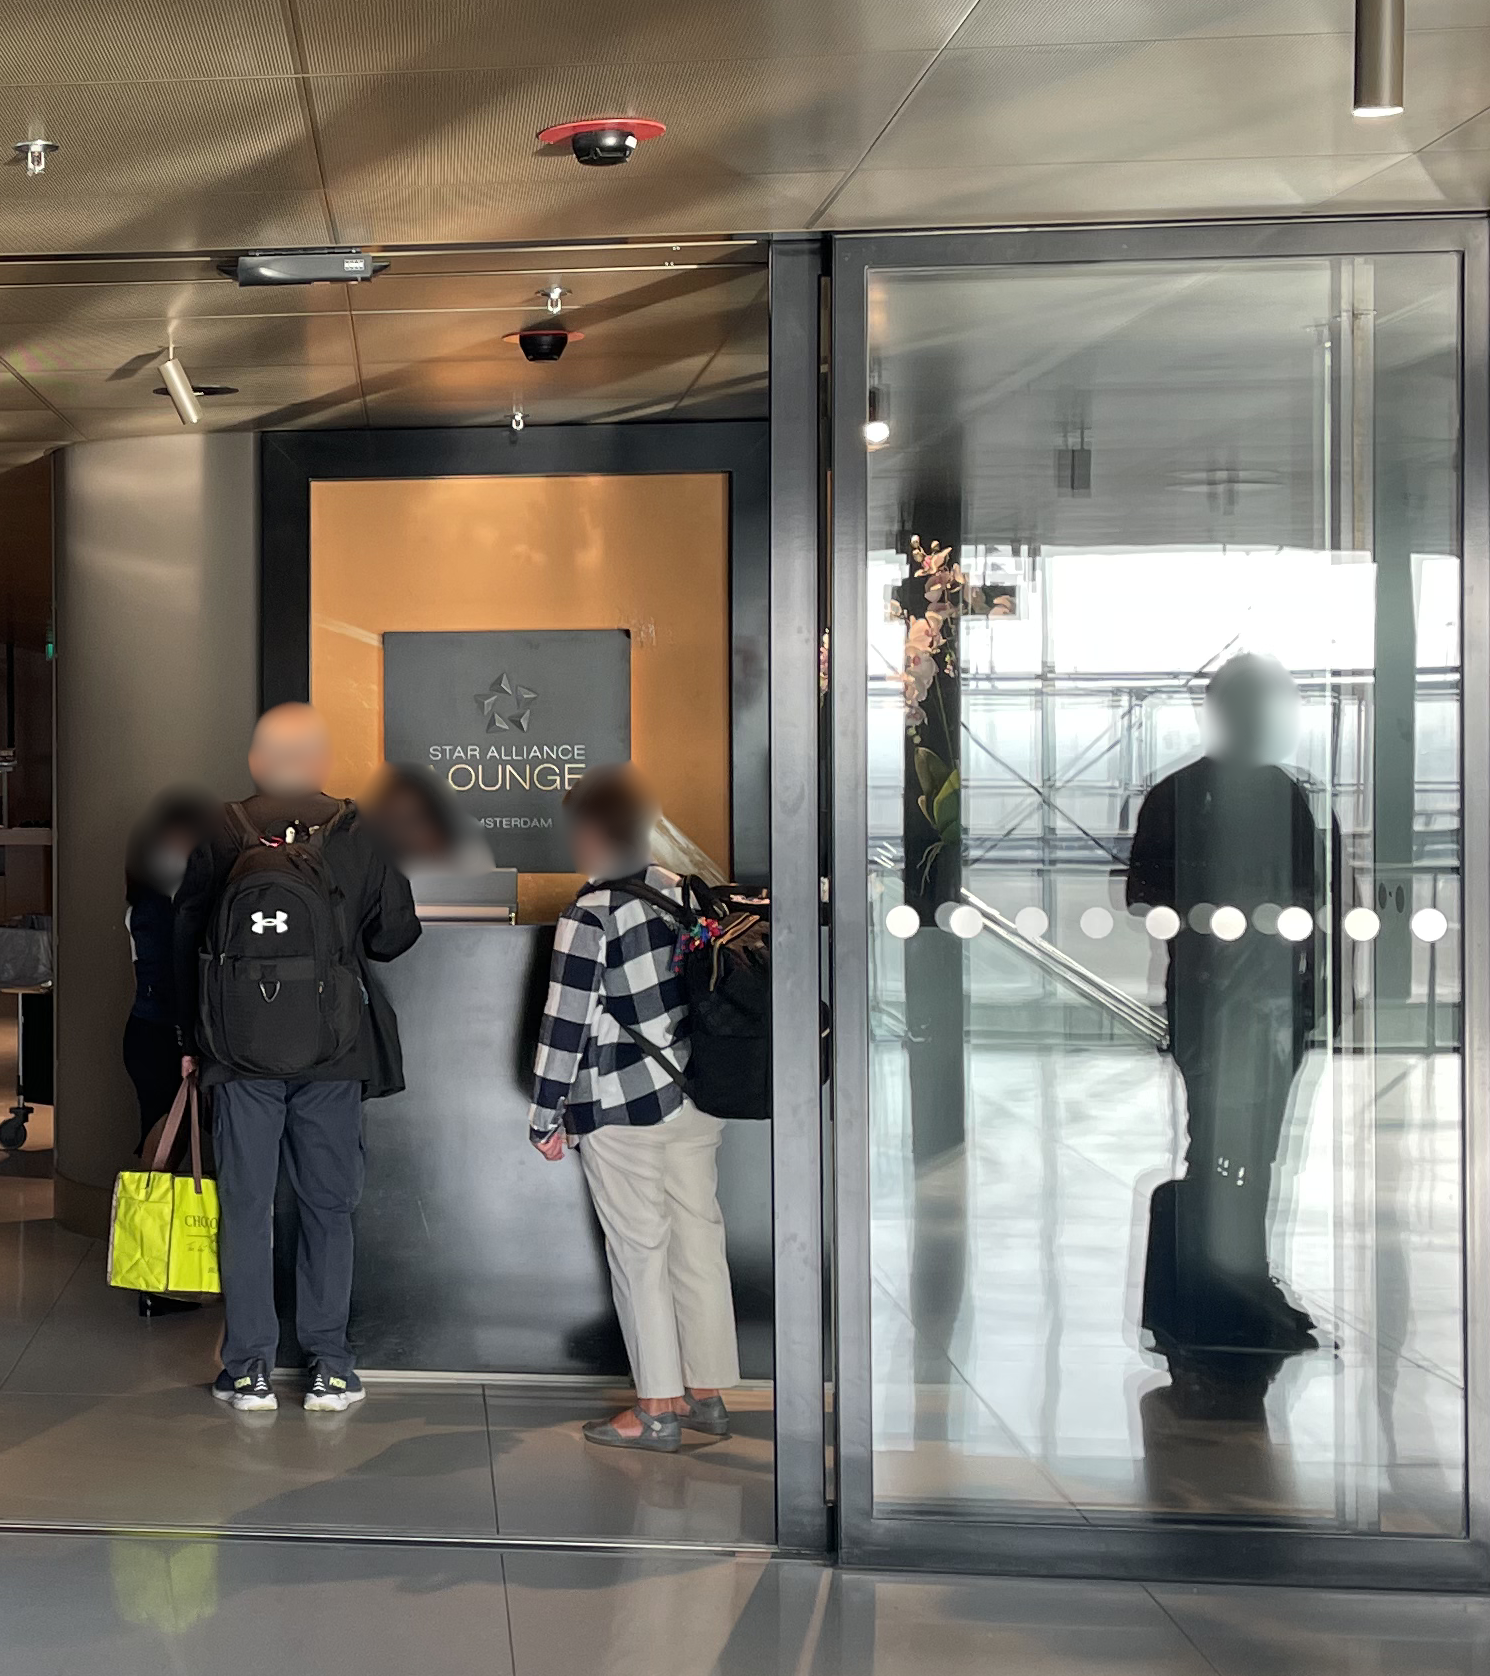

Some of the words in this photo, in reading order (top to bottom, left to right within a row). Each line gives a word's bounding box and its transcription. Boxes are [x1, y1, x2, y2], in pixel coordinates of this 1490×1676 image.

[429, 745, 480, 760] STAR
[486, 745, 586, 760] ALLIANCE
[429, 763, 586, 790] OUNGE
[479, 817, 553, 828] STERDAM
